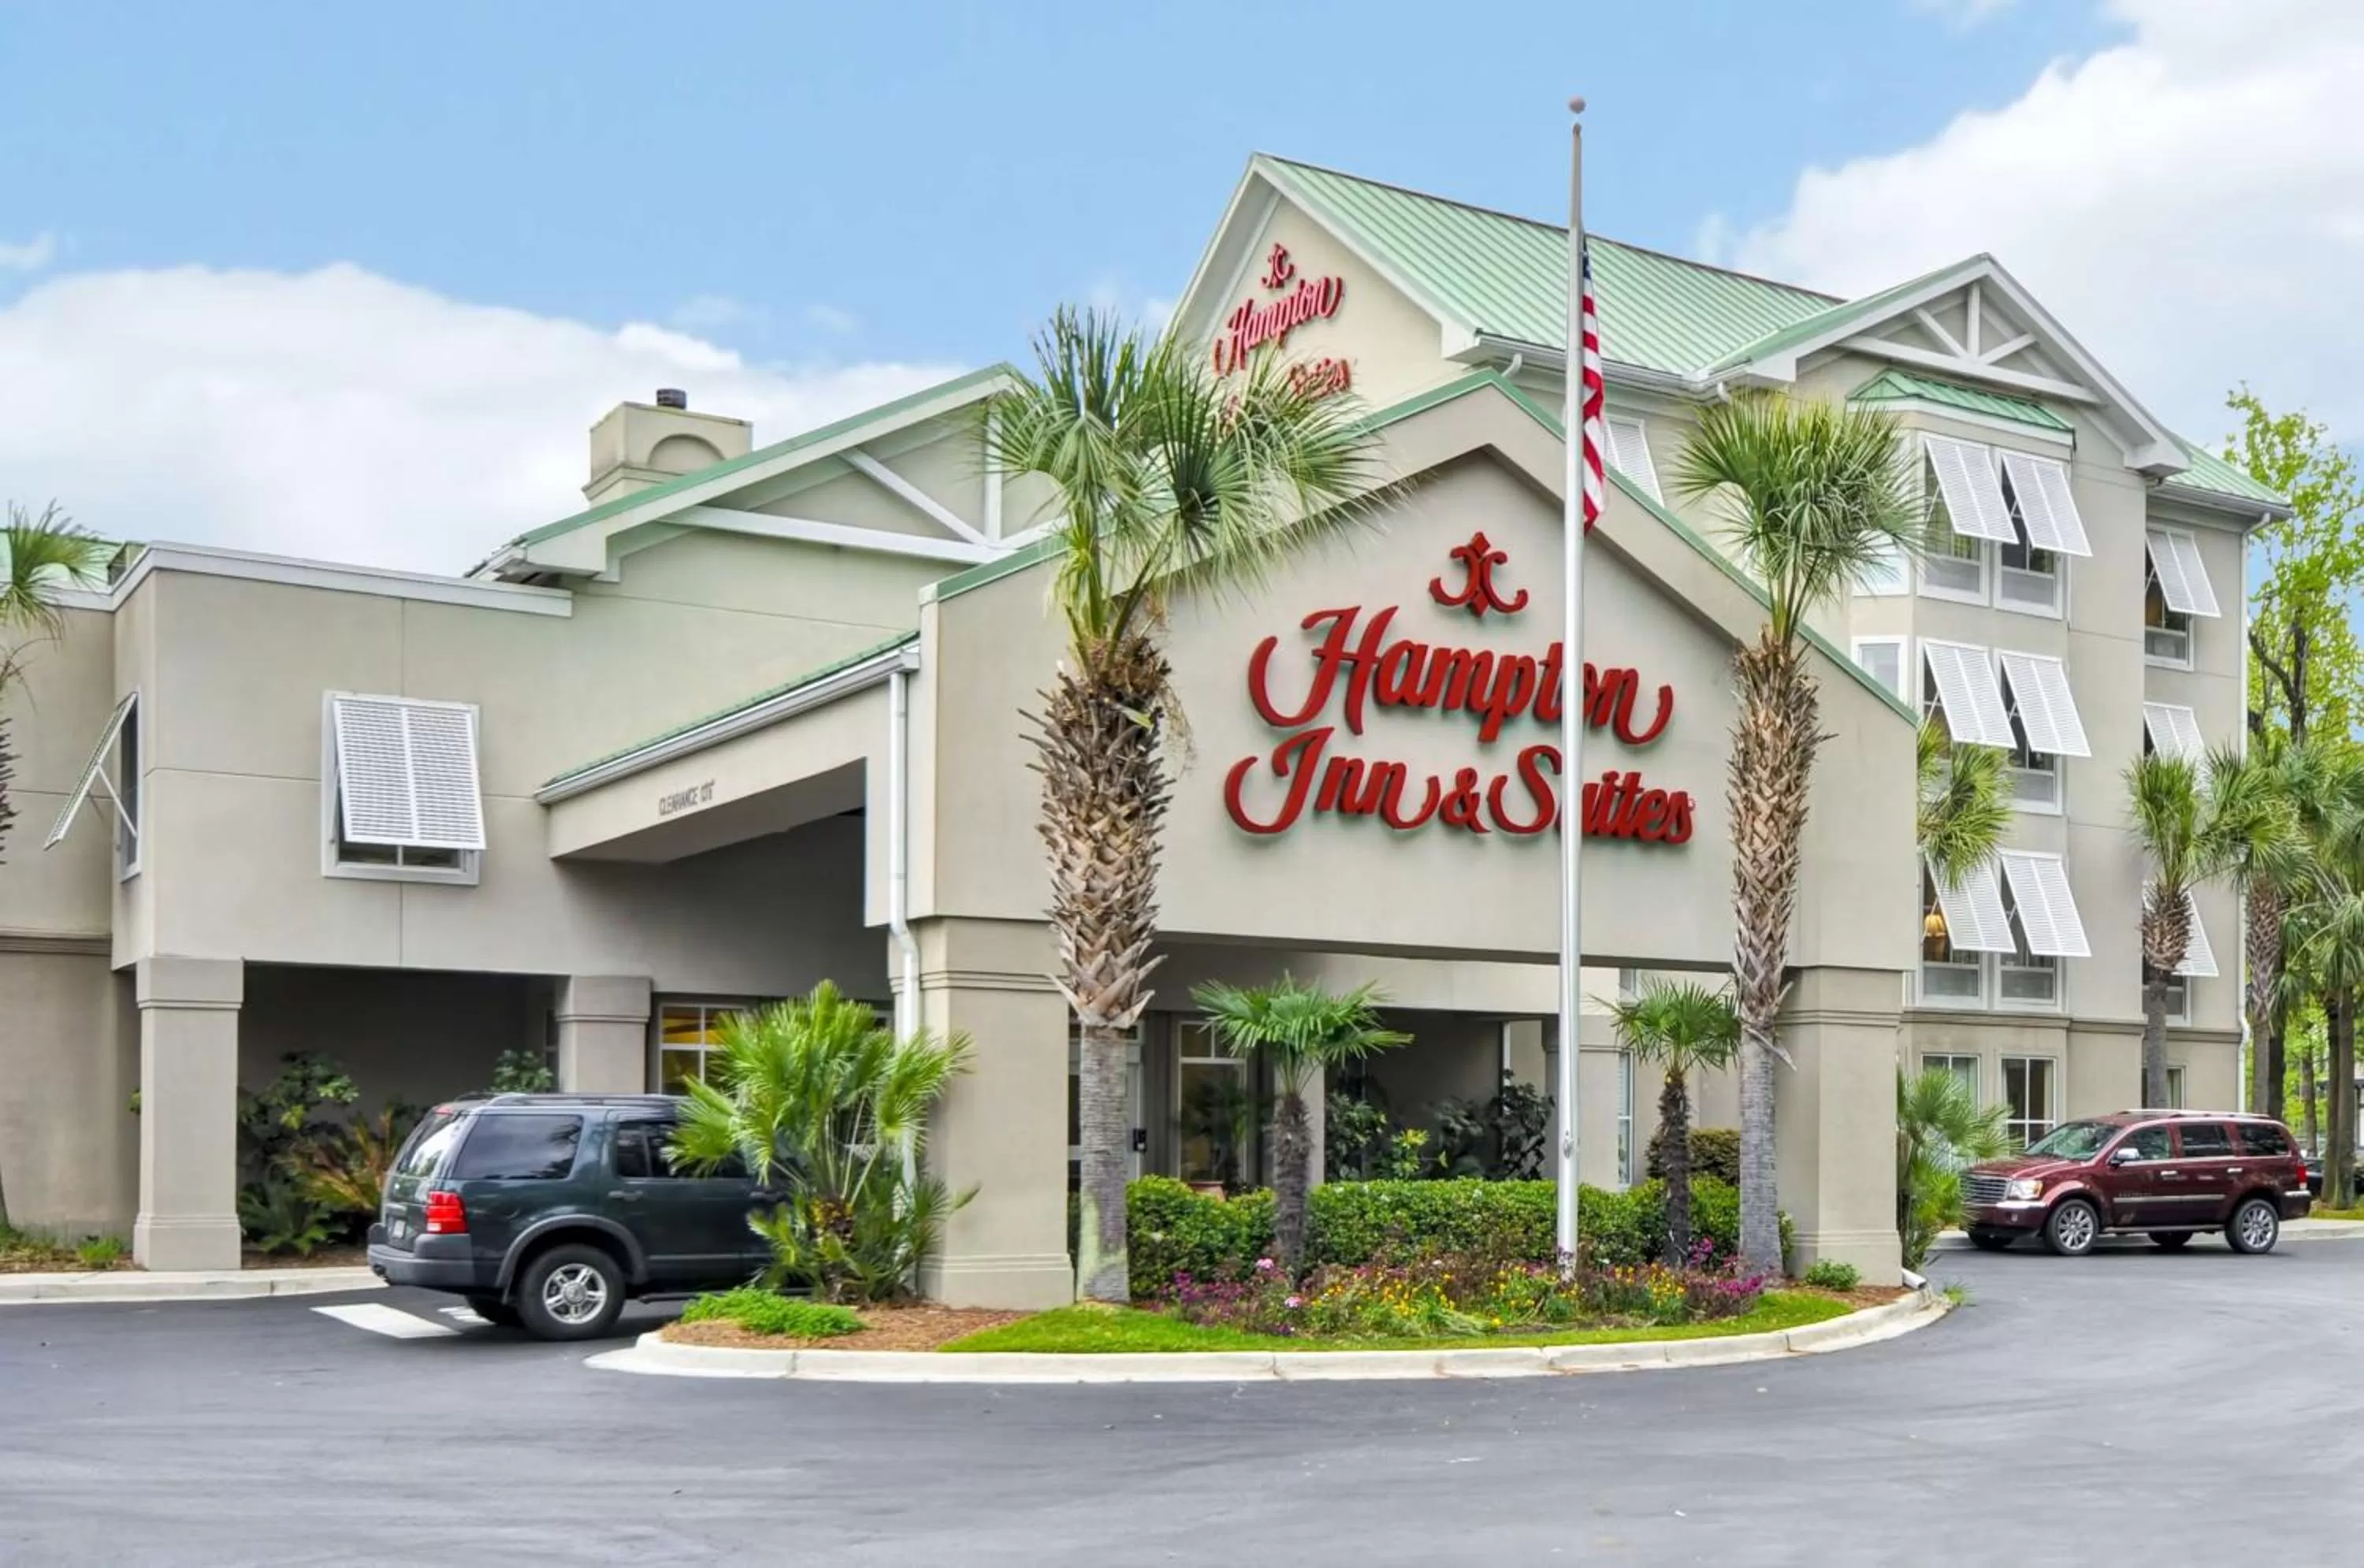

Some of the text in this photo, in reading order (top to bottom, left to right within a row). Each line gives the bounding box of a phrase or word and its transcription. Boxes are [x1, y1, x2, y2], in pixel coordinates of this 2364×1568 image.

[1214, 276, 1344, 377] Hampton
[1225, 726, 1440, 834] Inn
[1439, 767, 1491, 834] &
